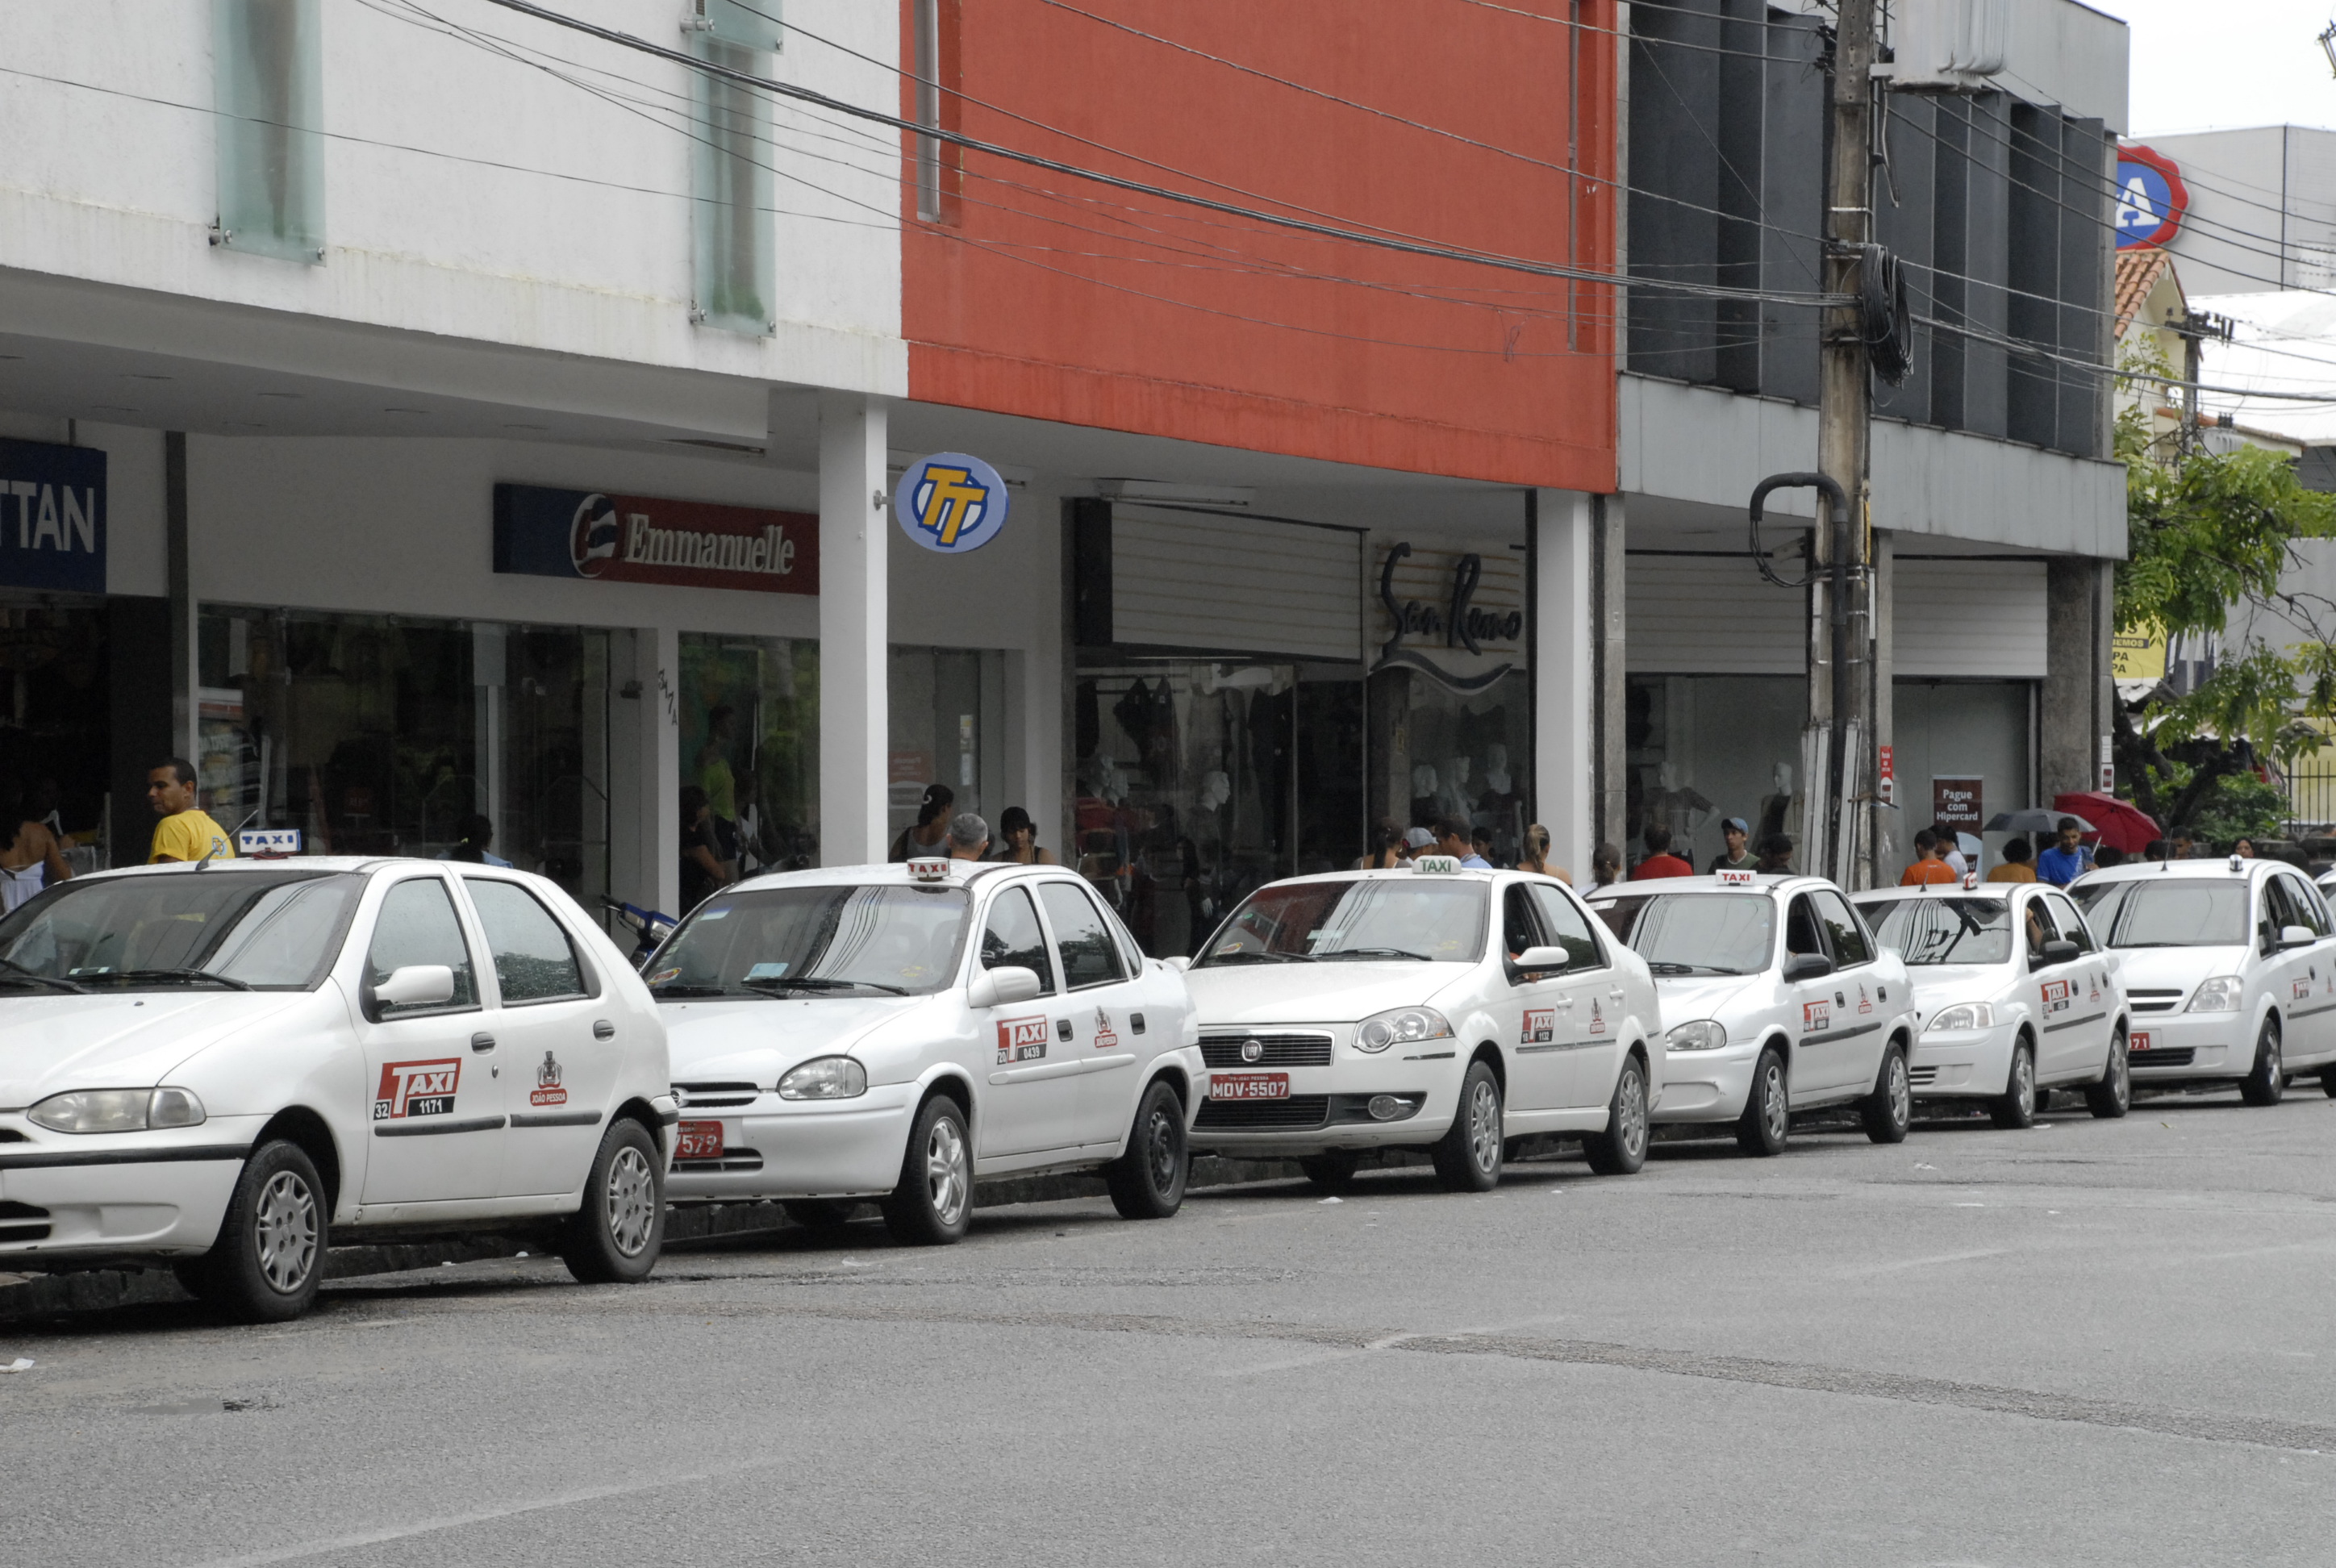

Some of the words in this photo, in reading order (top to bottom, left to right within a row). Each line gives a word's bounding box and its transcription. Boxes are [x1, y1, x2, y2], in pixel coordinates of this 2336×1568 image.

[624, 513, 795, 574] Emmanuelle
[1942, 789, 1973, 802] Pague
[1947, 803, 1968, 811] com
[1937, 811, 1978, 822] Hipercard
[242, 835, 294, 844] TAXI
[908, 864, 947, 873] TAXI
[1420, 859, 1451, 872] TAXI
[1722, 873, 1750, 882] TAXI
[2044, 982, 2065, 1011] TAXI
[1807, 1002, 1829, 1029] TAXI
[1529, 1011, 1554, 1040] TAXI
[1002, 1016, 1046, 1061] TAXI
[998, 1051, 1007, 1063] 20
[1024, 1046, 1041, 1059] 0439
[1245, 1046, 1258, 1057] FIAT
[392, 1062, 457, 1115] TAXI
[532, 1092, 545, 1103] JOÃO
[546, 1092, 565, 1103] PESSOA
[375, 1103, 388, 1118] 32
[419, 1099, 442, 1114] 1171
